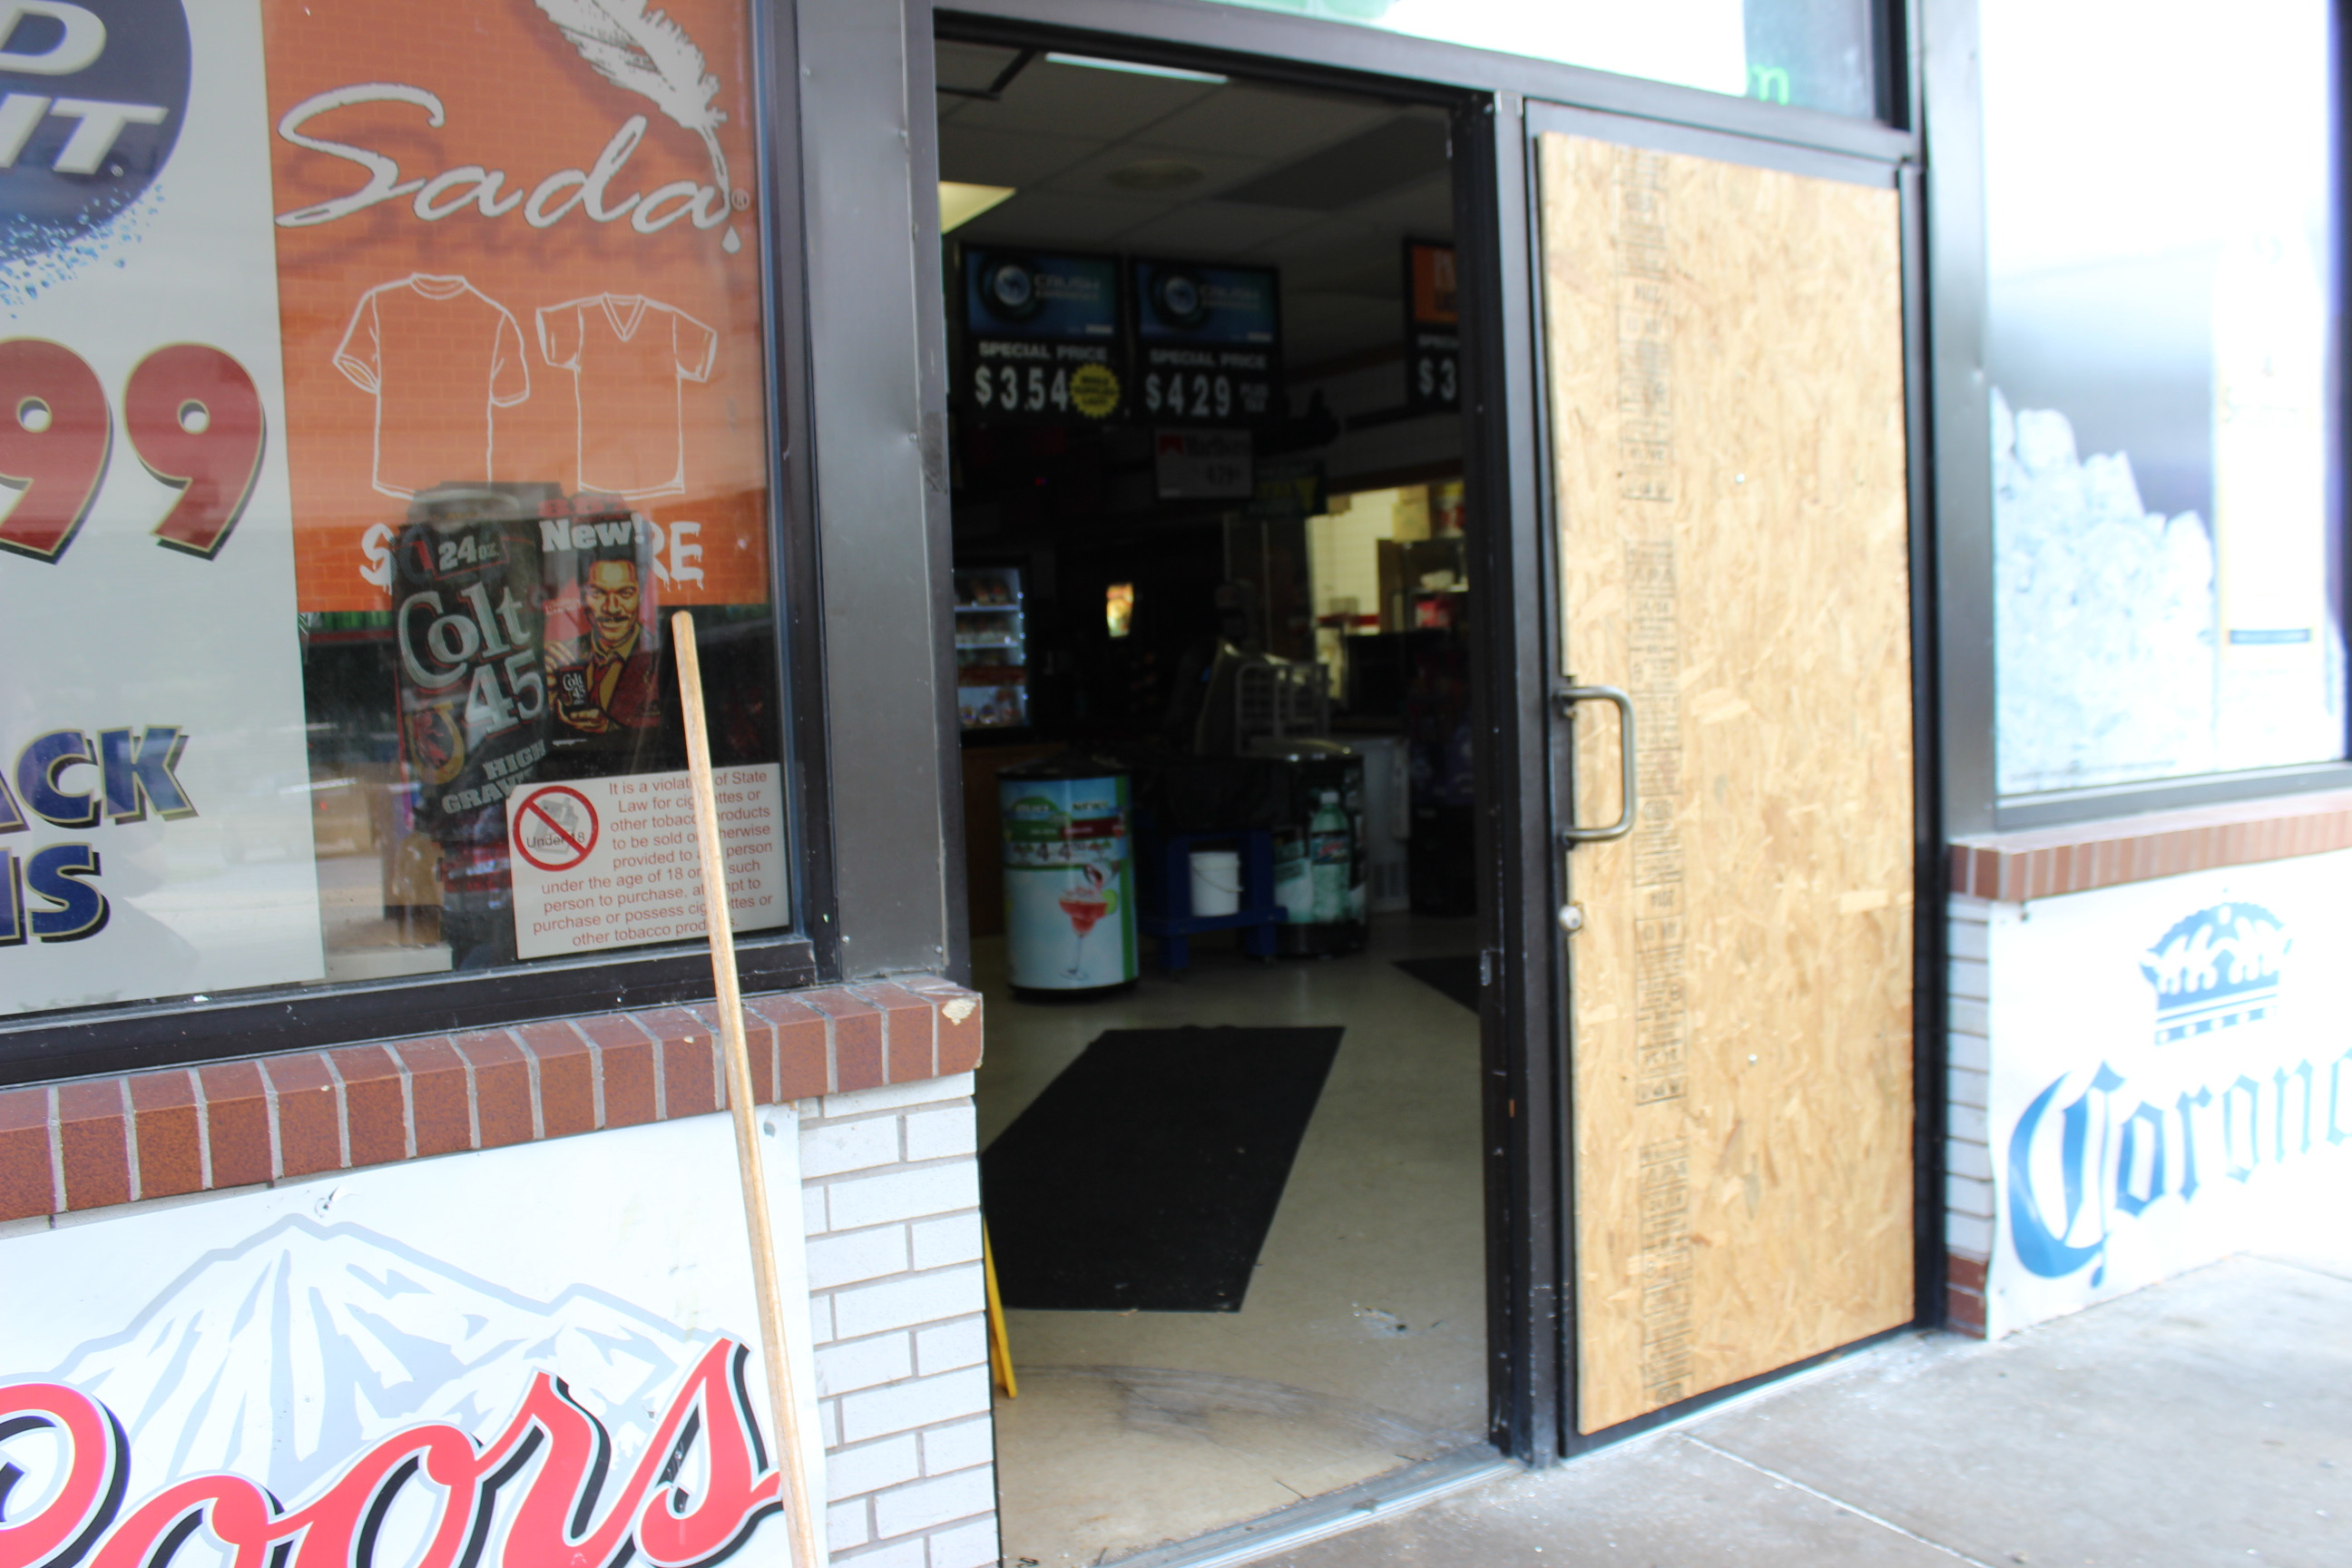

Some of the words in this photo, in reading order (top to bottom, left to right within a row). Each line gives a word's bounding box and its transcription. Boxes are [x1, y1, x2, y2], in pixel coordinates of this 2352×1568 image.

[274, 82, 729, 231] Sada
[978, 341, 1051, 360] SPECIAL
[1056, 345, 1108, 363] PRICE
[1149, 348, 1217, 368] SPECIAL
[1220, 351, 1268, 370] PRICE
[538, 513, 645, 553] New!
[438, 535, 477, 571] 24
[397, 581, 531, 690] Colt
[464, 650, 545, 736] 45
[482, 740, 546, 780] HIGH
[609, 781, 619, 795] It
[622, 780, 634, 794] is
[639, 782, 648, 793] a
[714, 772, 729, 786] of
[731, 770, 768, 785] State
[618, 799, 648, 813] Law
[652, 796, 671, 809] for
[747, 789, 761, 800] or
[610, 818, 648, 832] other
[652, 814, 696, 828] tobacc
[612, 838, 626, 850] to
[630, 836, 649, 849] be
[652, 832, 682, 846] sold
[612, 849, 675, 871] provided
[679, 849, 692, 861] to
[726, 842, 773, 858] person
[541, 878, 585, 895] under
[588, 877, 612, 890] the
[615, 874, 643, 889] age
[647, 869, 662, 883] of
[667, 867, 683, 880] 18
[728, 860, 760, 874] such
[544, 897, 594, 916] person
[599, 895, 613, 906] to
[748, 877, 762, 890] to
[533, 915, 602, 936] purchase
[605, 912, 621, 924] or
[624, 906, 684, 924] possess
[759, 895, 773, 906] or
[572, 931, 611, 946] other
[614, 926, 671, 942] tobacco
